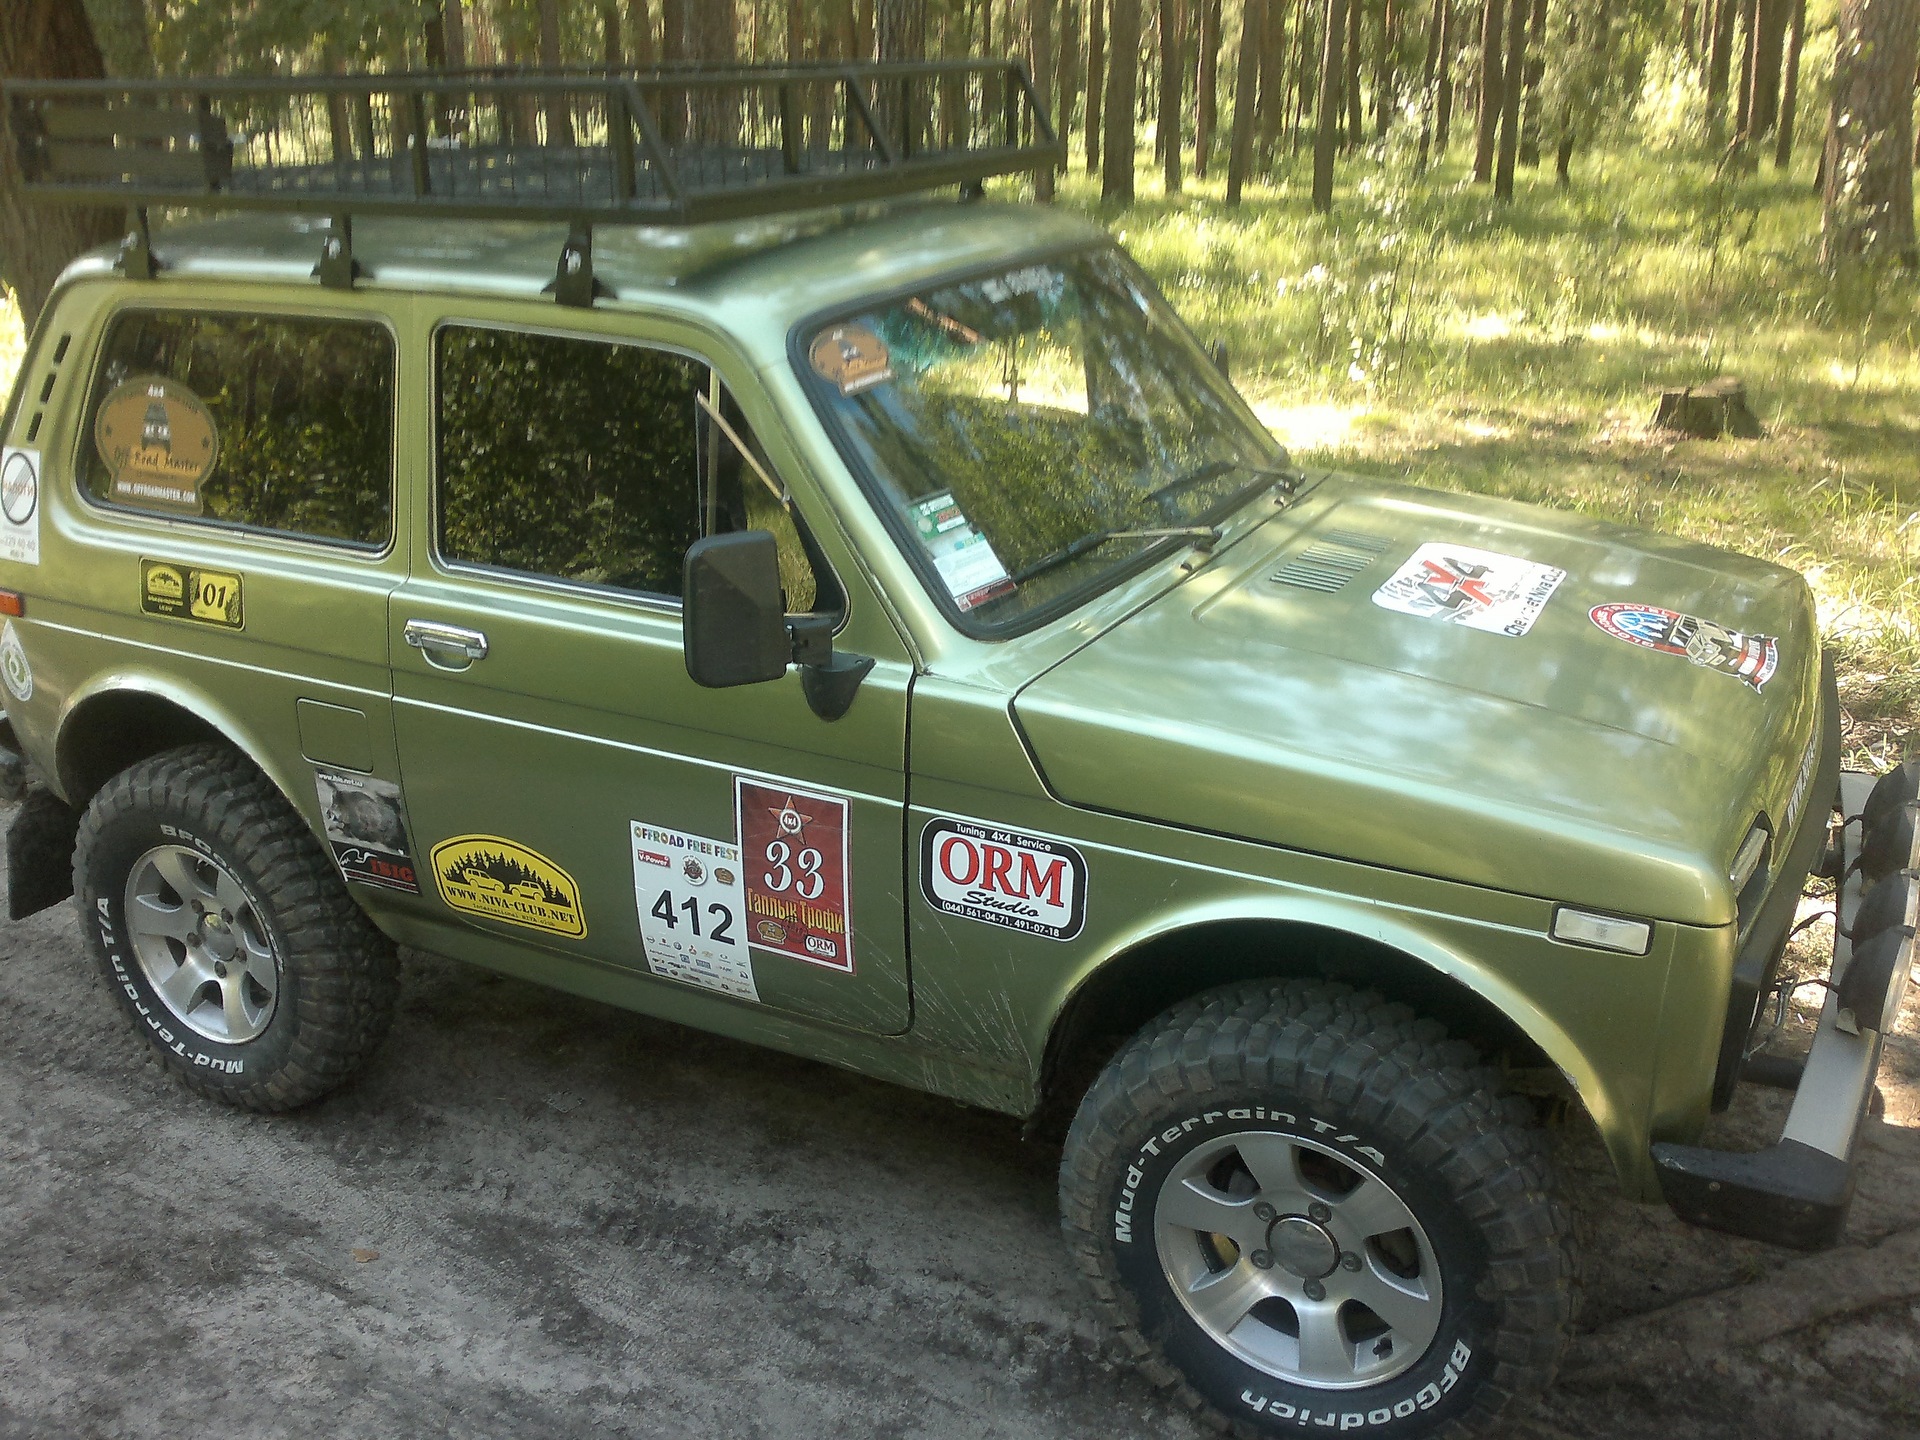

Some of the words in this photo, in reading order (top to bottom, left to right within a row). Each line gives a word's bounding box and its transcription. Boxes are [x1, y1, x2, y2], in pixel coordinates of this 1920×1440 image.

[634, 826, 685, 848] OFFROAD
[687, 838, 712, 855] FREE
[714, 845, 739, 862] FEST
[956, 823, 986, 839] Tuning
[1016, 836, 1052, 852] Service
[638, 853, 668, 867] V-Power
[764, 840, 825, 900] 33
[939, 837, 1068, 908] ORM
[445, 885, 576, 924] WWW.NIVA-CLUB.NET
[651, 889, 736, 946] 412
[941, 900, 965, 915] (044)
[1014, 919, 1060, 938] 491-07-18
[962, 890, 1040, 918] Studio
[807, 937, 834, 953] ORM
[111, 954, 244, 1074] Mud-Terrain
[1115, 1106, 1298, 1243] Mud-Terrain
[1310, 1117, 1386, 1168] T/A
[1240, 1339, 1473, 1431] BFGoodrich
